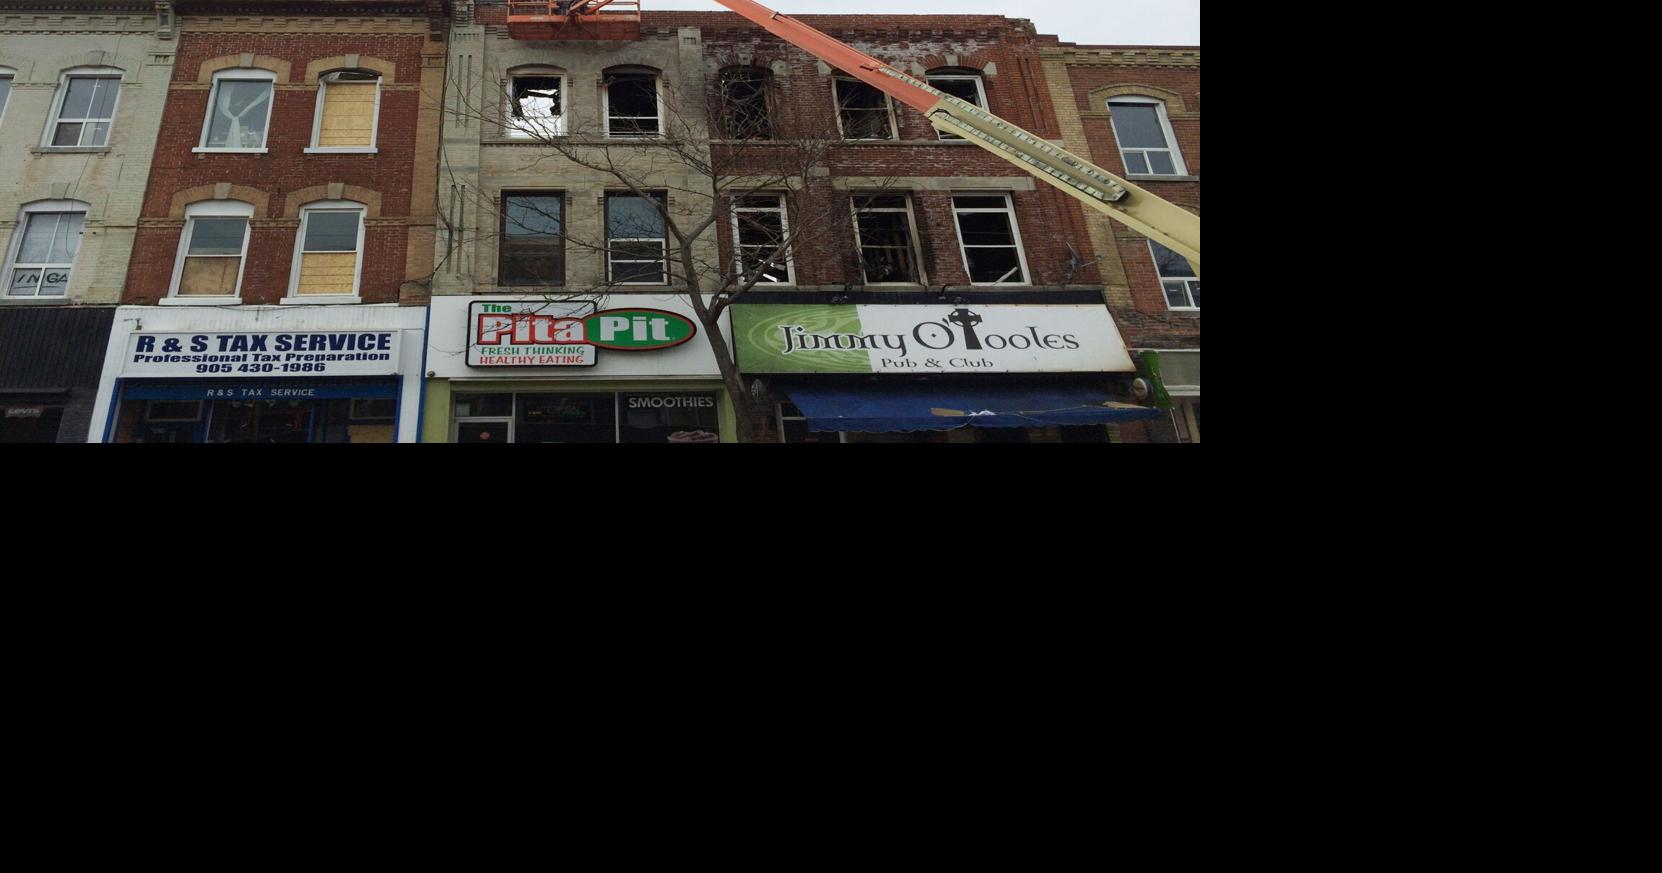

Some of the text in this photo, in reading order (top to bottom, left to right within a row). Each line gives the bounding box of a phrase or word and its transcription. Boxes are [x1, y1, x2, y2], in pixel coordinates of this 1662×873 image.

[482, 304, 512, 312] The
[481, 315, 671, 342] Pita Pit
[136, 333, 391, 353] R & S TAX SERVICE
[779, 326, 907, 357] Jimmy
[481, 345, 585, 355] FRESH THINKING
[133, 352, 390, 363] Professional Tax Preparation
[480, 355, 584, 365] HEALTHY EATING
[881, 357, 994, 368] Pub & Club
[196, 362, 326, 374] 905 430-1986
[206, 389, 215, 397] R
[226, 389, 234, 397] S
[242, 388, 263, 396] TAX
[271, 388, 316, 397] SERVICE
[629, 396, 714, 408] SMOOTHIES
